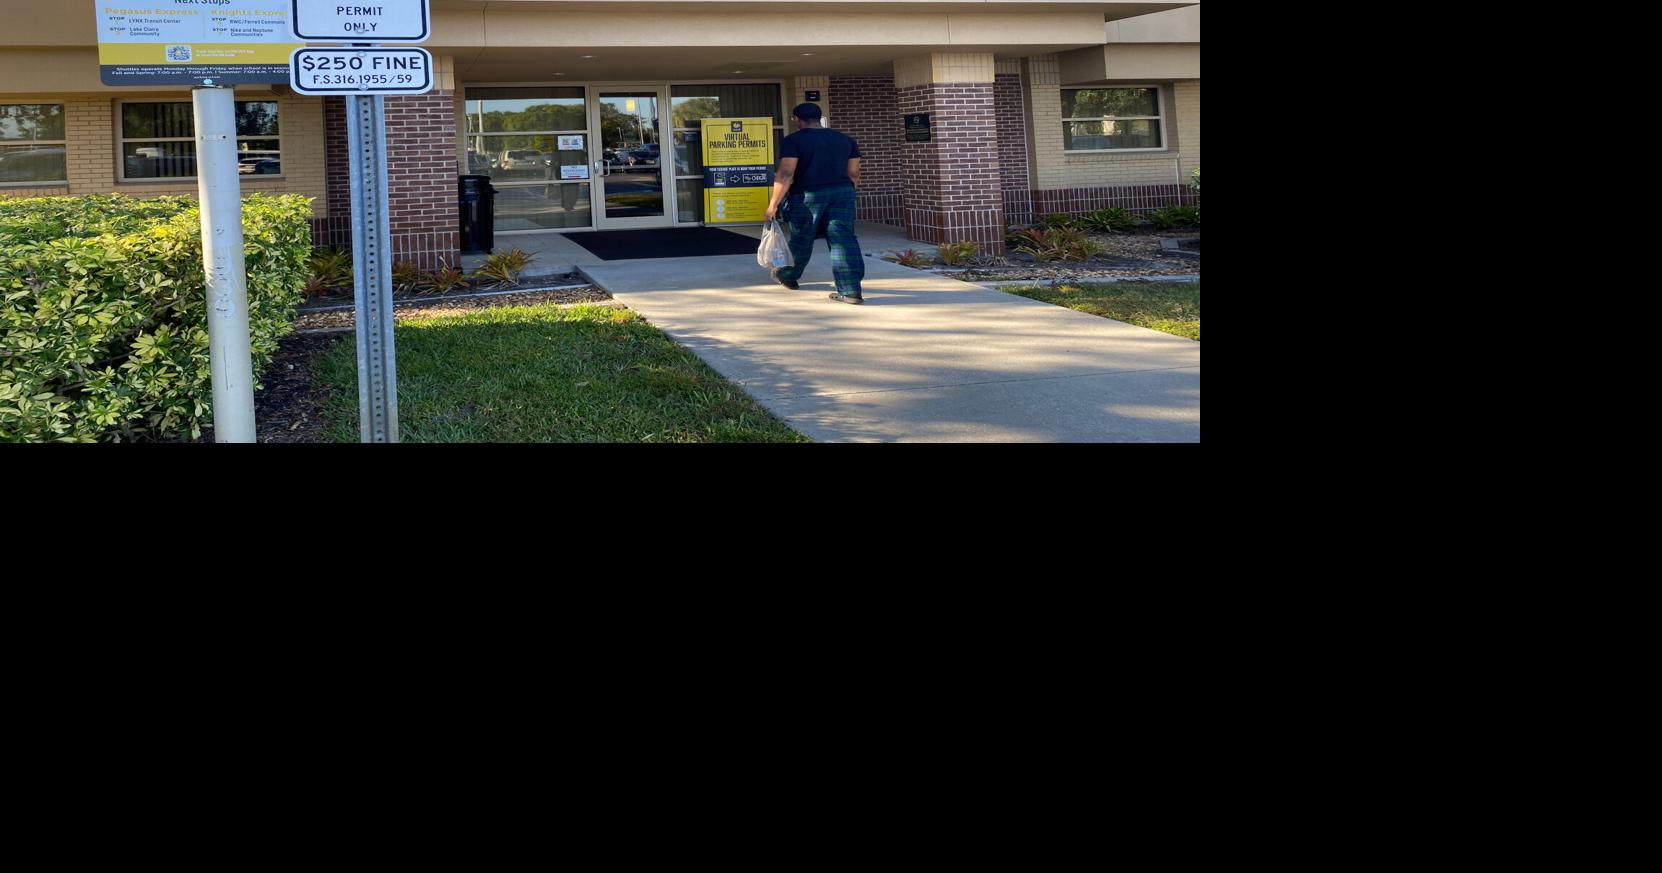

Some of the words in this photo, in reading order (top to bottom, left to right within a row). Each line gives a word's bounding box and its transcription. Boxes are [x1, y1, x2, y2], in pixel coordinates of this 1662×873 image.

[105, 7, 152, 15] Pegasus
[155, 8, 199, 16] Express
[210, 9, 252, 17] Knights
[336, 6, 384, 16] PERMIT
[344, 22, 378, 31] ONLY
[302, 55, 363, 71] $250
[372, 56, 422, 70] FINE
[313, 74, 412, 84] F.S.316.1955/59
[709, 140, 737, 149] PARKING
